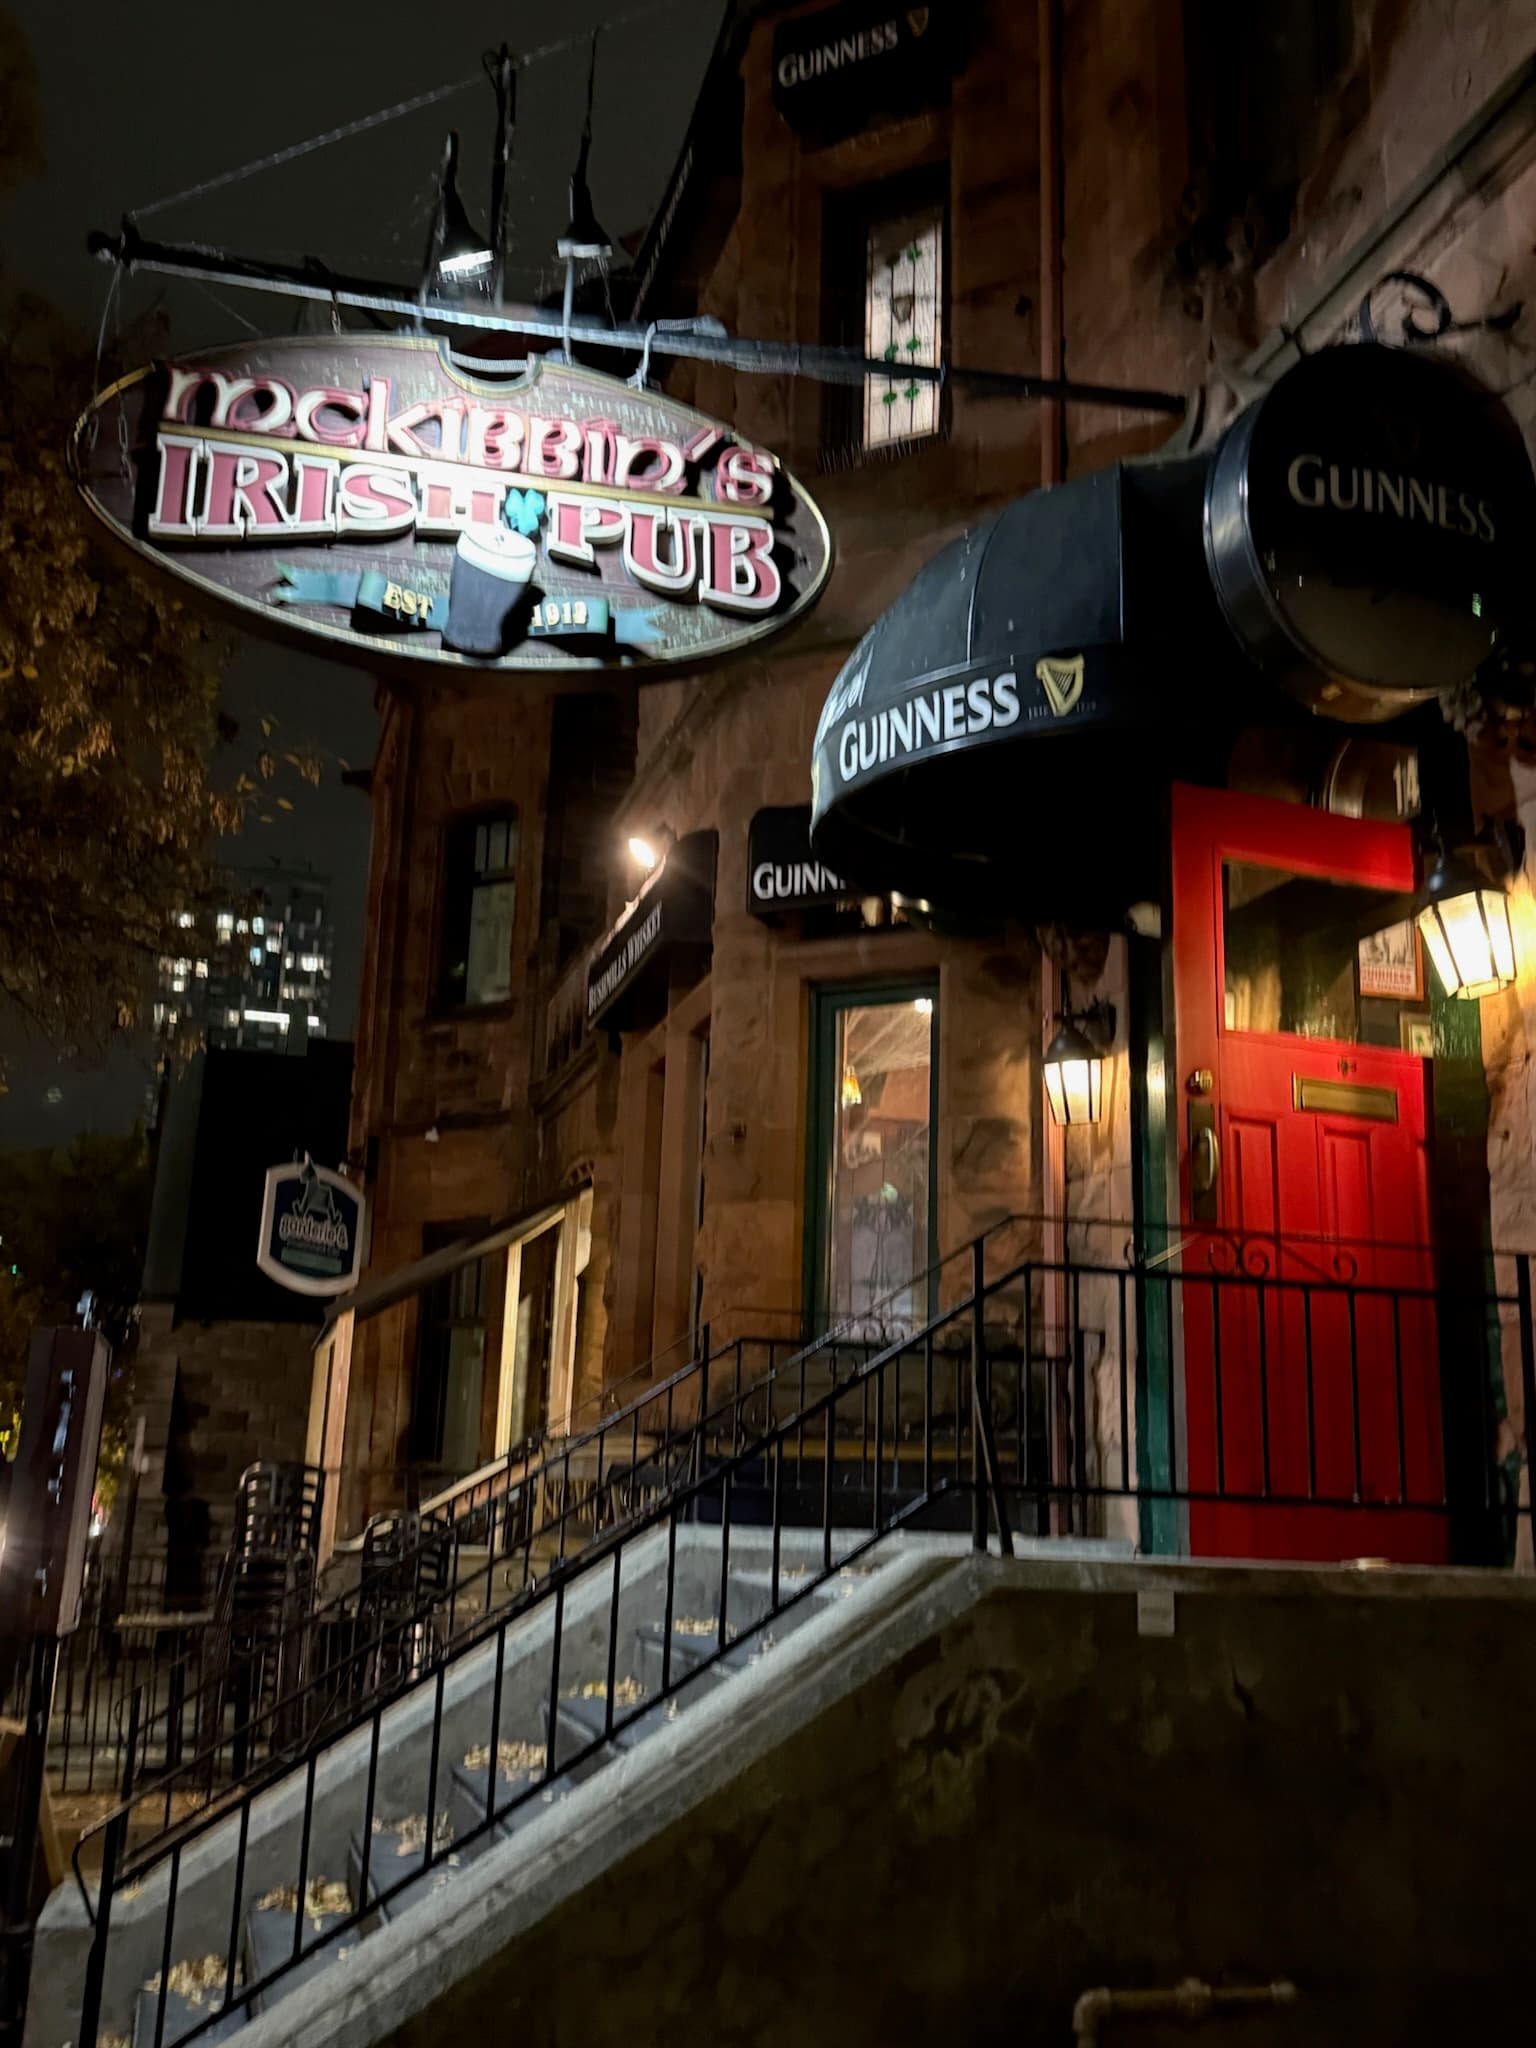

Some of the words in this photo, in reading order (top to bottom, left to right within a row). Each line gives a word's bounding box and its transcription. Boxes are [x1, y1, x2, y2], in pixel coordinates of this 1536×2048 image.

[778, 19, 898, 88] GUINNESS
[148, 432, 507, 543] IRISH
[546, 491, 783, 612] PUB
[1288, 453, 1496, 543] GUINNESS
[839, 672, 1020, 782] GUINNESS
[753, 860, 847, 900] GUINN
